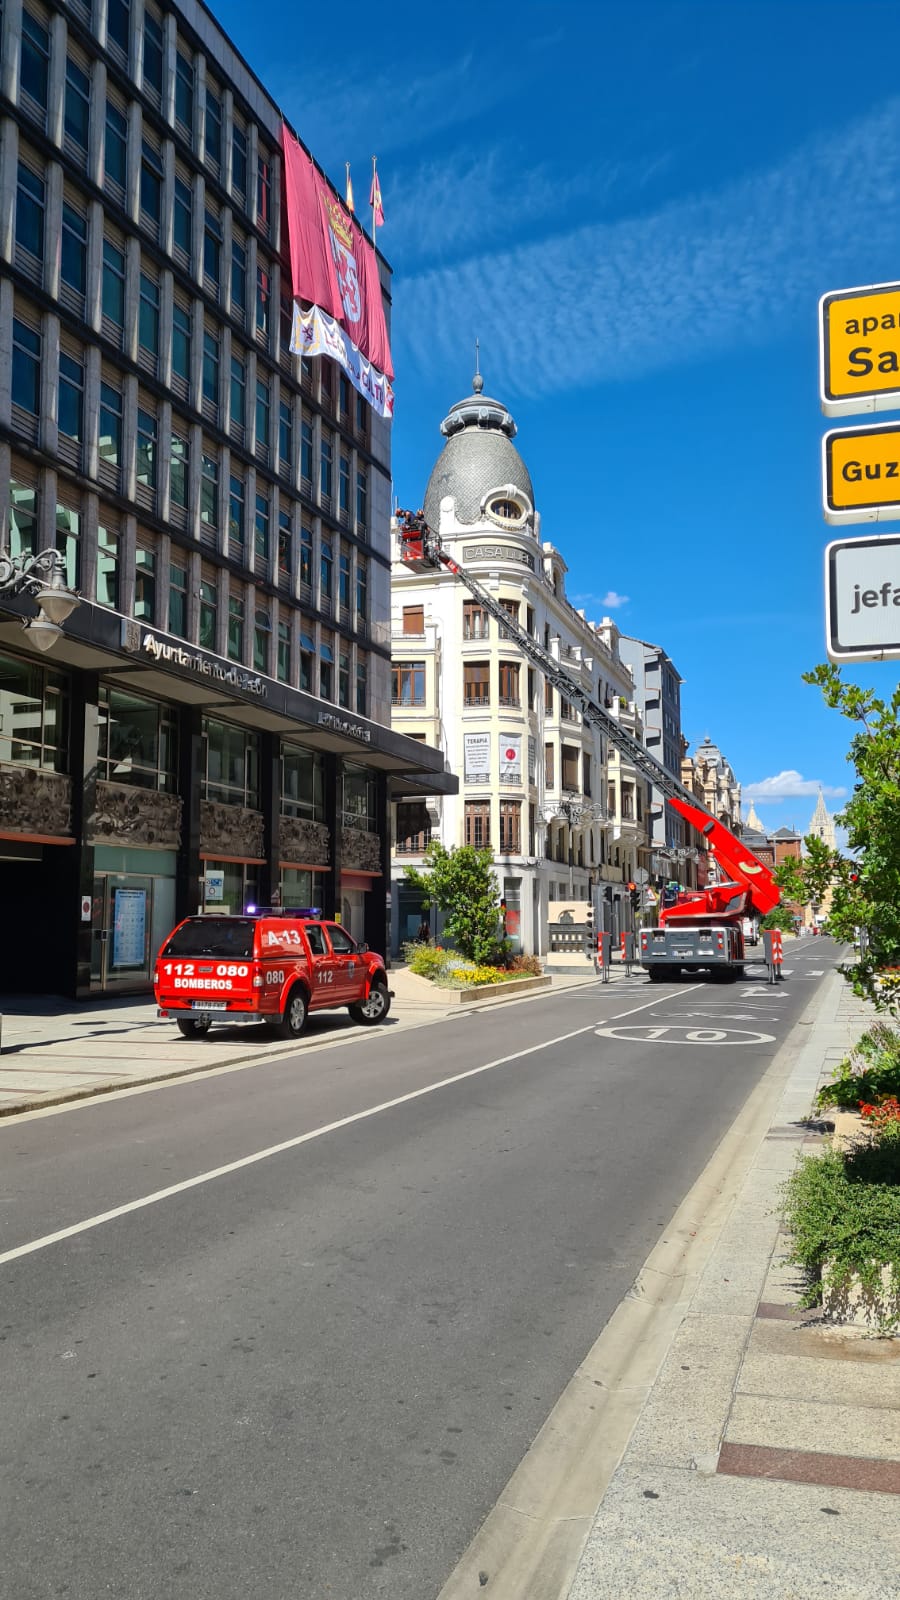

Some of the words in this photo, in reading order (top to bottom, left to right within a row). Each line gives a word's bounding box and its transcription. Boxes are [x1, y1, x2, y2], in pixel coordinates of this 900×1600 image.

[847, 347, 899, 377] Sa
[842, 461, 899, 482] Guz
[465, 546, 504, 560] CASA
[143, 634, 227, 681] Ayuntamiento
[268, 930, 301, 946] A-13
[164, 963, 195, 976] 112
[216, 965, 248, 977] 080
[266, 970, 285, 984] 080
[317, 970, 333, 983] 112
[174, 978, 233, 990] BOMBEROS
[645, 1028, 728, 1042] 10
